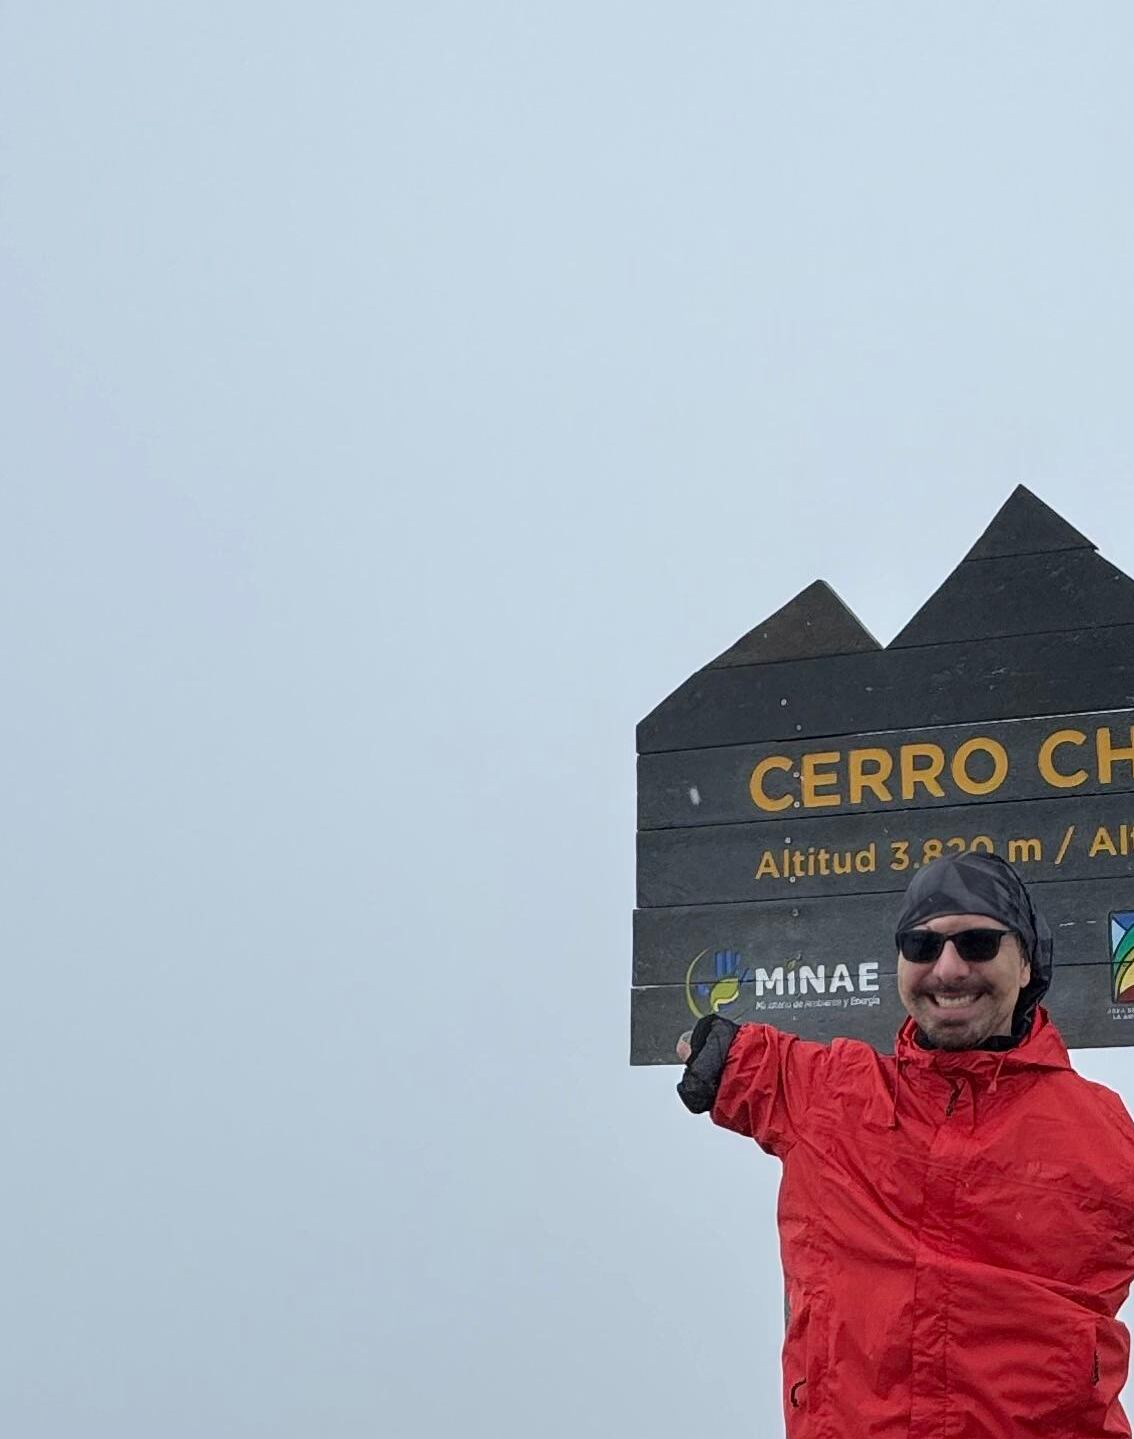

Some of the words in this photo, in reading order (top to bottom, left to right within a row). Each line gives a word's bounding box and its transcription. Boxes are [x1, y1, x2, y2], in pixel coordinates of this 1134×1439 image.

[749, 737, 1009, 812] CERRO
[755, 842, 876, 879] Altitud
[1008, 838, 1042, 863] m
[1055, 825, 1075, 865] /
